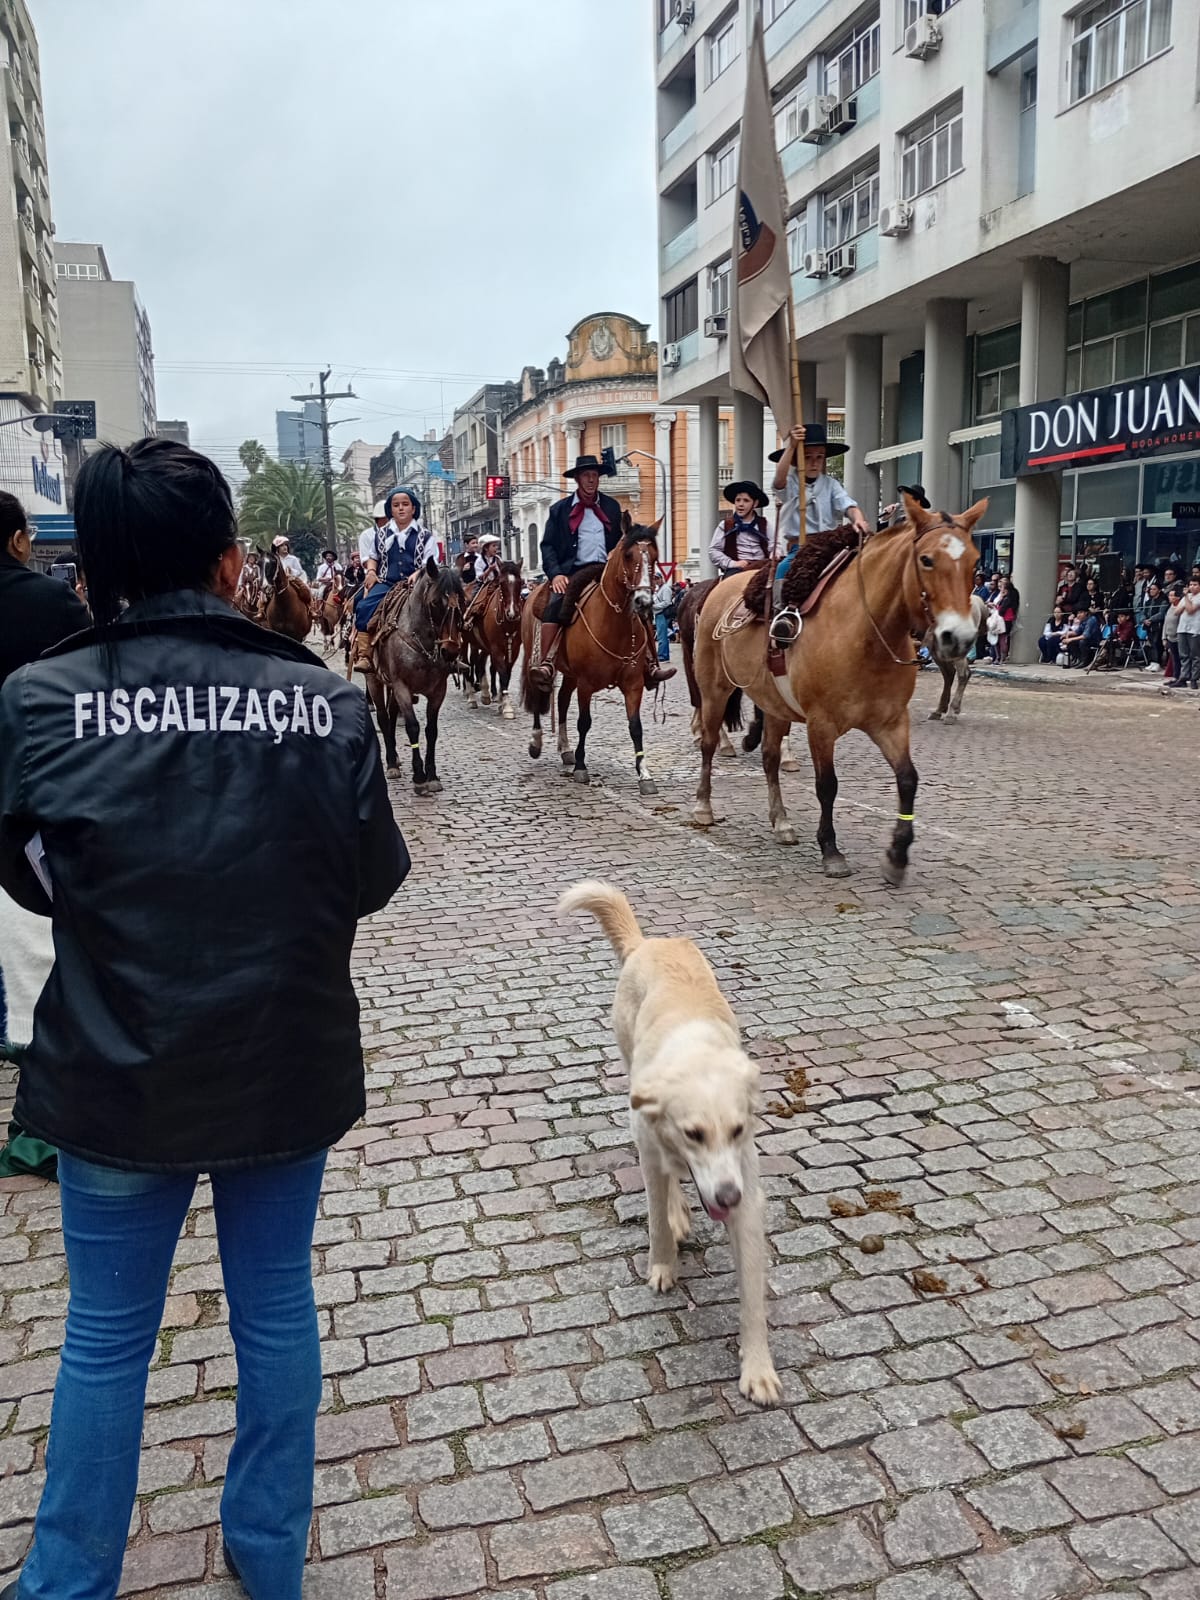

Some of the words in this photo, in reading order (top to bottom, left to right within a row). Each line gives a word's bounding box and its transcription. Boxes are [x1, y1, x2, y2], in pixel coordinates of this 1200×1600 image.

[1029, 398, 1099, 453] DON
[1109, 376, 1200, 439] JUAN
[74, 686, 333, 744] FISCALIZAÇÃO
